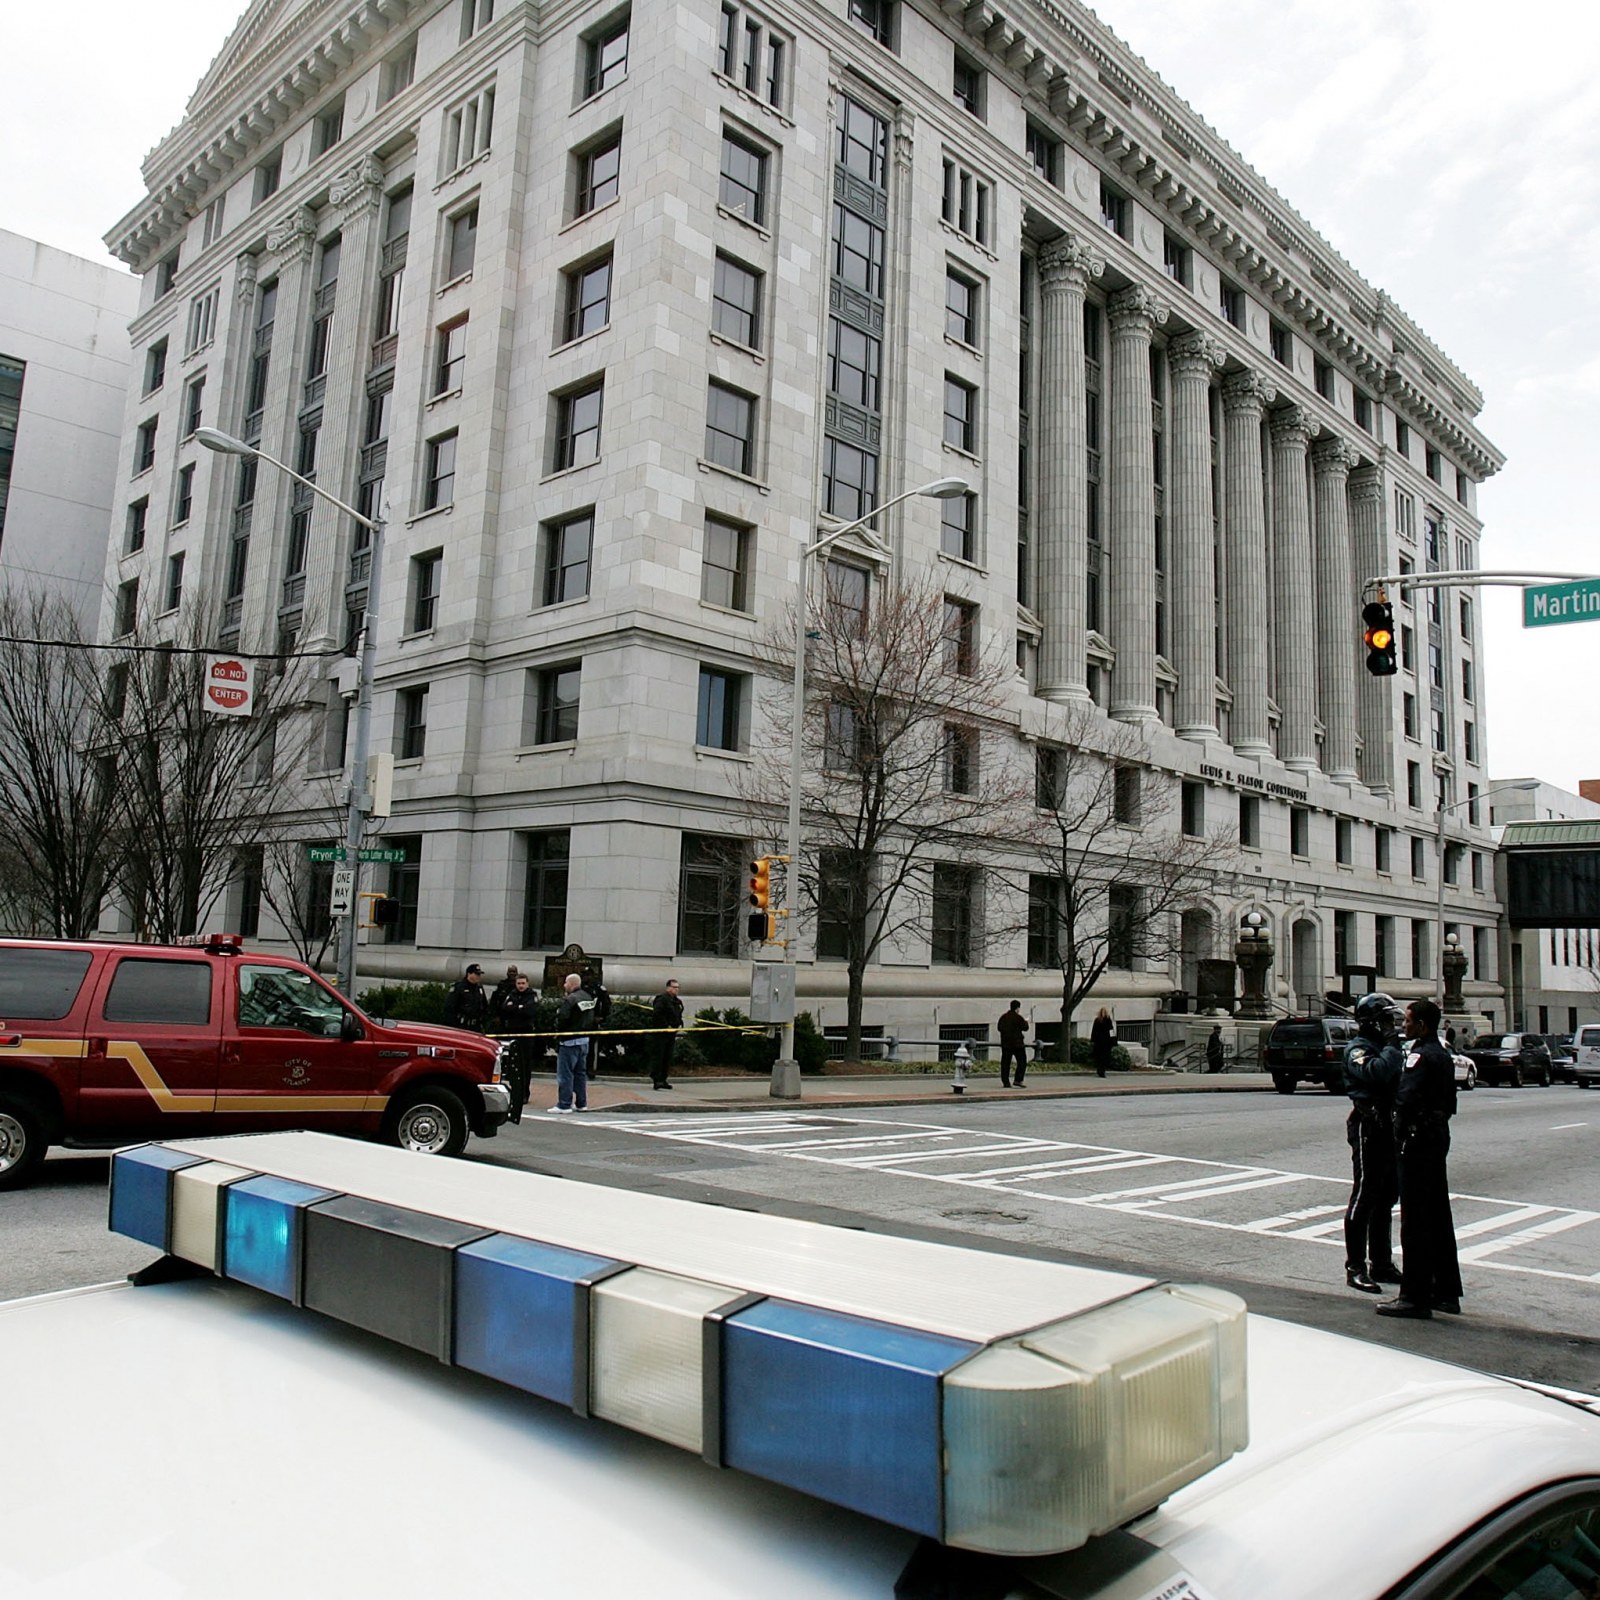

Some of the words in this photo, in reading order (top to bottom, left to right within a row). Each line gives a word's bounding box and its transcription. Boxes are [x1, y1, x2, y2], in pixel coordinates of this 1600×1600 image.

[1533, 588, 1600, 618] Martin
[214, 667, 225, 677] DO
[230, 670, 246, 679] NOT
[215, 689, 242, 700] ENTER
[1200, 763, 1223, 779] LEWIS
[311, 850, 333, 861] Pryor
[336, 872, 350, 884] ONE
[334, 887, 350, 898] WAY
